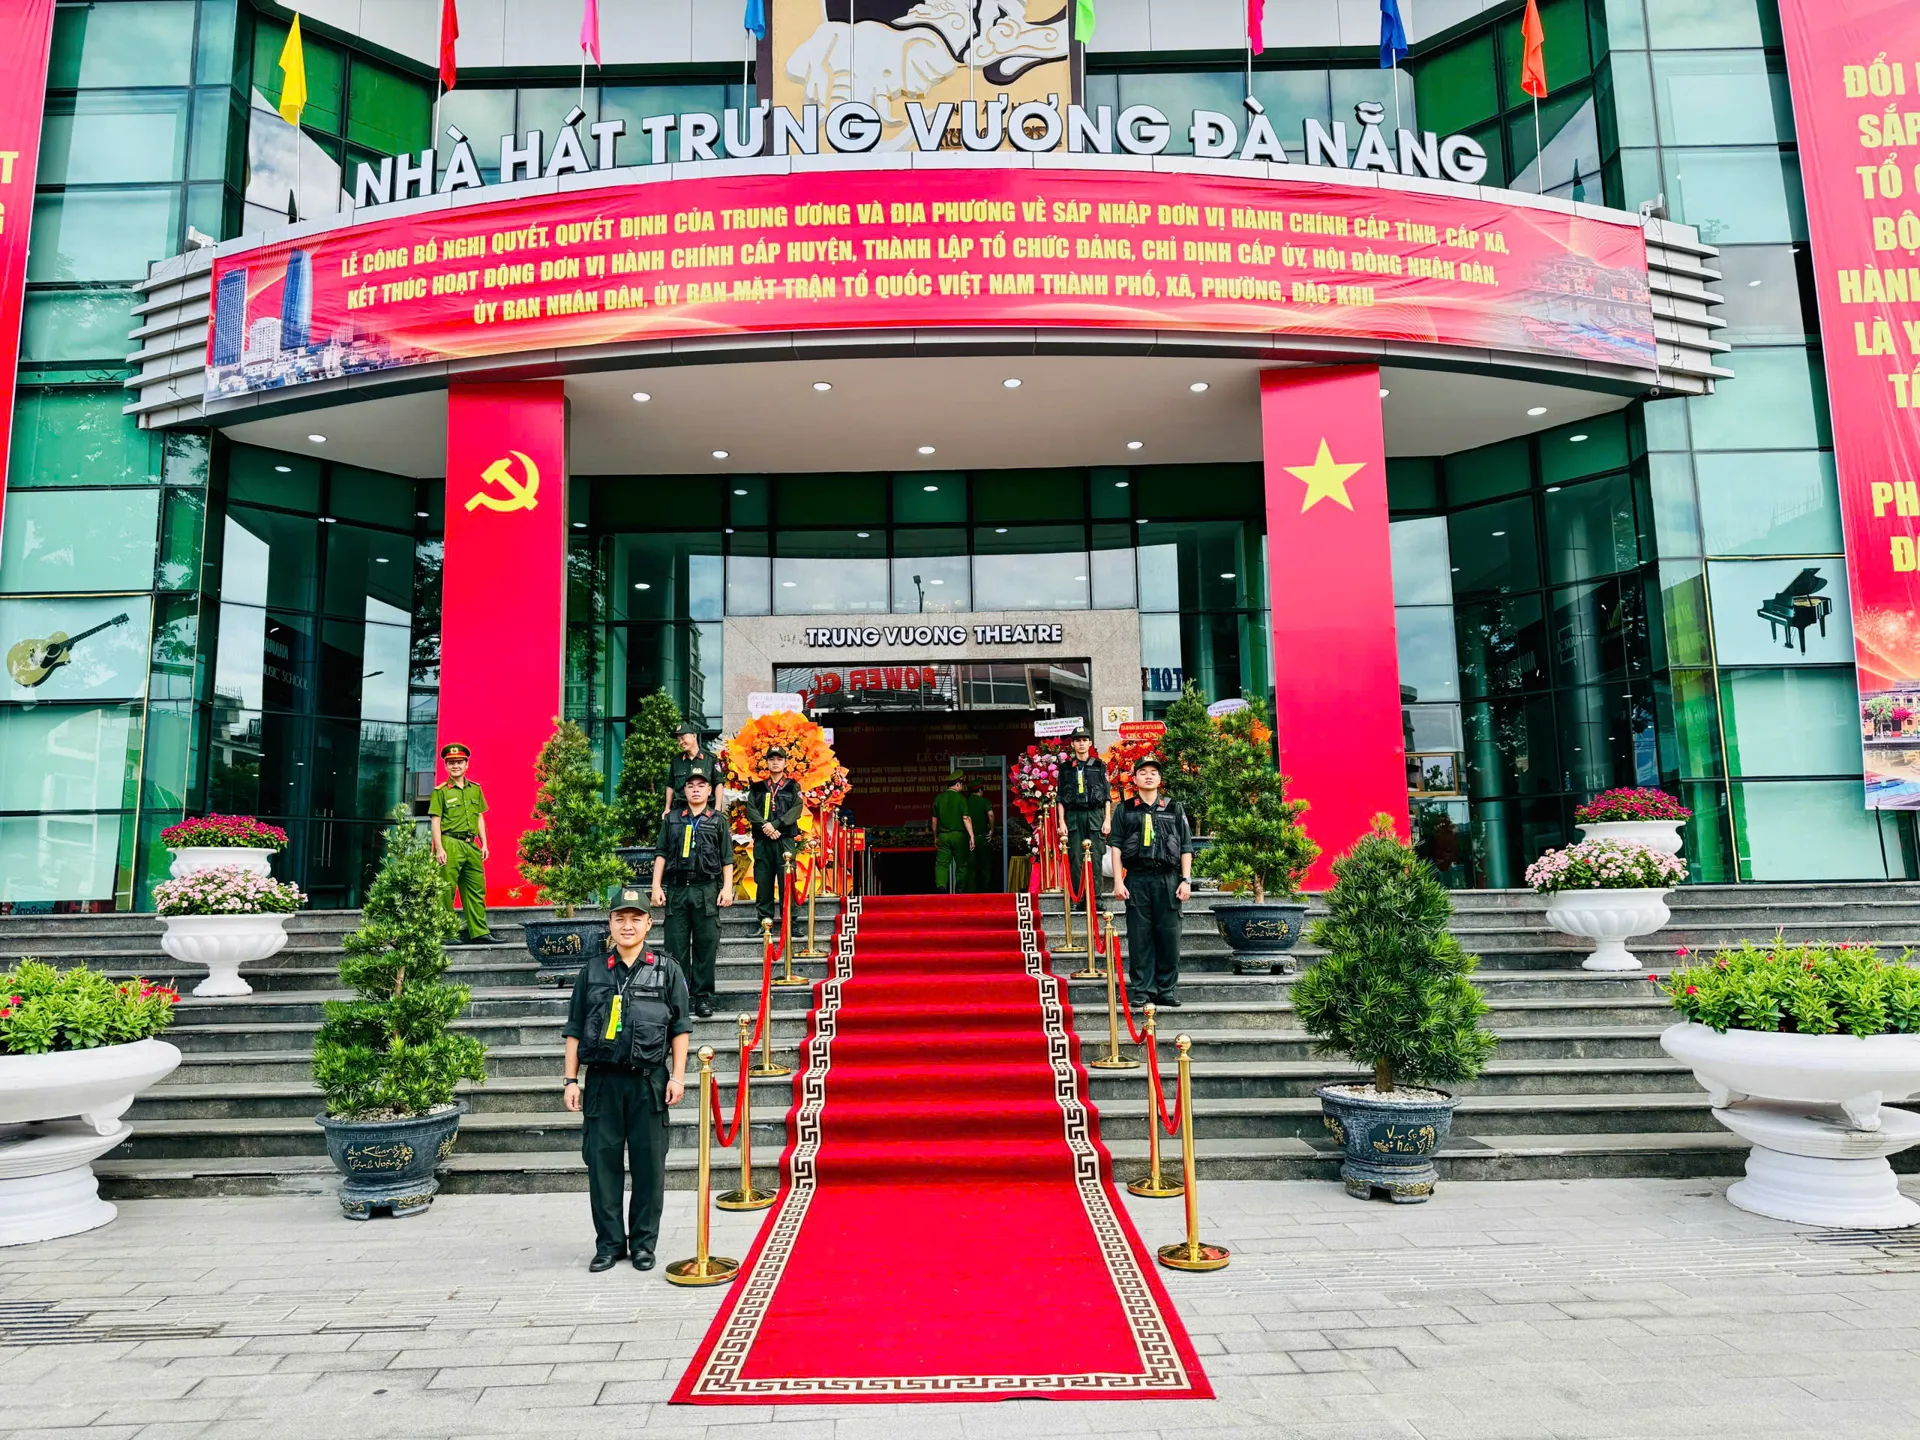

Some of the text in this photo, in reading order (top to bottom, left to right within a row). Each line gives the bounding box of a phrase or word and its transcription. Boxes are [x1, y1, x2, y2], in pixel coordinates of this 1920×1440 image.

[1843, 51, 1906, 98] ĐỔI
[353, 92, 1489, 209] NHÀ HÁT TRƯNG VƯƠNG ĐÀ NẴNG
[1856, 152, 1903, 199] TỔ
[341, 251, 358, 278] LỄ
[362, 243, 408, 272] CÔNG
[413, 236, 438, 264] BỐ
[442, 235, 486, 261] NGHỊ
[491, 222, 550, 255] QUYẾT,
[555, 214, 615, 247] QUYẾT
[620, 214, 668, 240] ĐỊNH
[674, 206, 715, 234] CỦA
[720, 207, 788, 230] TRUNG
[794, 201, 851, 227] ƯƠNG
[856, 200, 885, 224] VÀ
[890, 202, 927, 227] ĐỊA
[932, 198, 1015, 222] PHƯƠNG
[1021, 195, 1047, 222] VỀ
[1098, 200, 1152, 228] NHẬP
[1157, 202, 1199, 227] ĐƠN
[1204, 205, 1225, 231] VỊ
[1231, 205, 1284, 232] HÀNH
[1289, 211, 1348, 237] CHÍNH
[1353, 212, 1390, 240] CẤP
[1445, 223, 1480, 249] CẤP
[1483, 231, 1511, 256] XÃ,
[1872, 209, 1920, 256] BỘ
[347, 230, 1500, 310] KẾT THÚC HOẠT ĐỘNG ĐƠN VỊ HÀNH CHÍNH CẤP HUYỆN, THÀNH LẬP TỔ CHỨC ĐẢNG, CHỈ ĐỊNH CẤP ỦY, HỘI ĐỒNG NHÂN DÂN,
[473, 267, 1375, 325] ỦY BAN NHÂN DÂN, ỦY BAN MẶT TRẬN TỔ QUỐC VIỆT NAM THÀNH PHỐ, XÃ, PHƯỜNG, ĐẶC KHU
[1854, 315, 1896, 356] LÀ
[806, 624, 1063, 647] TRUNG VUONG THEATRE
